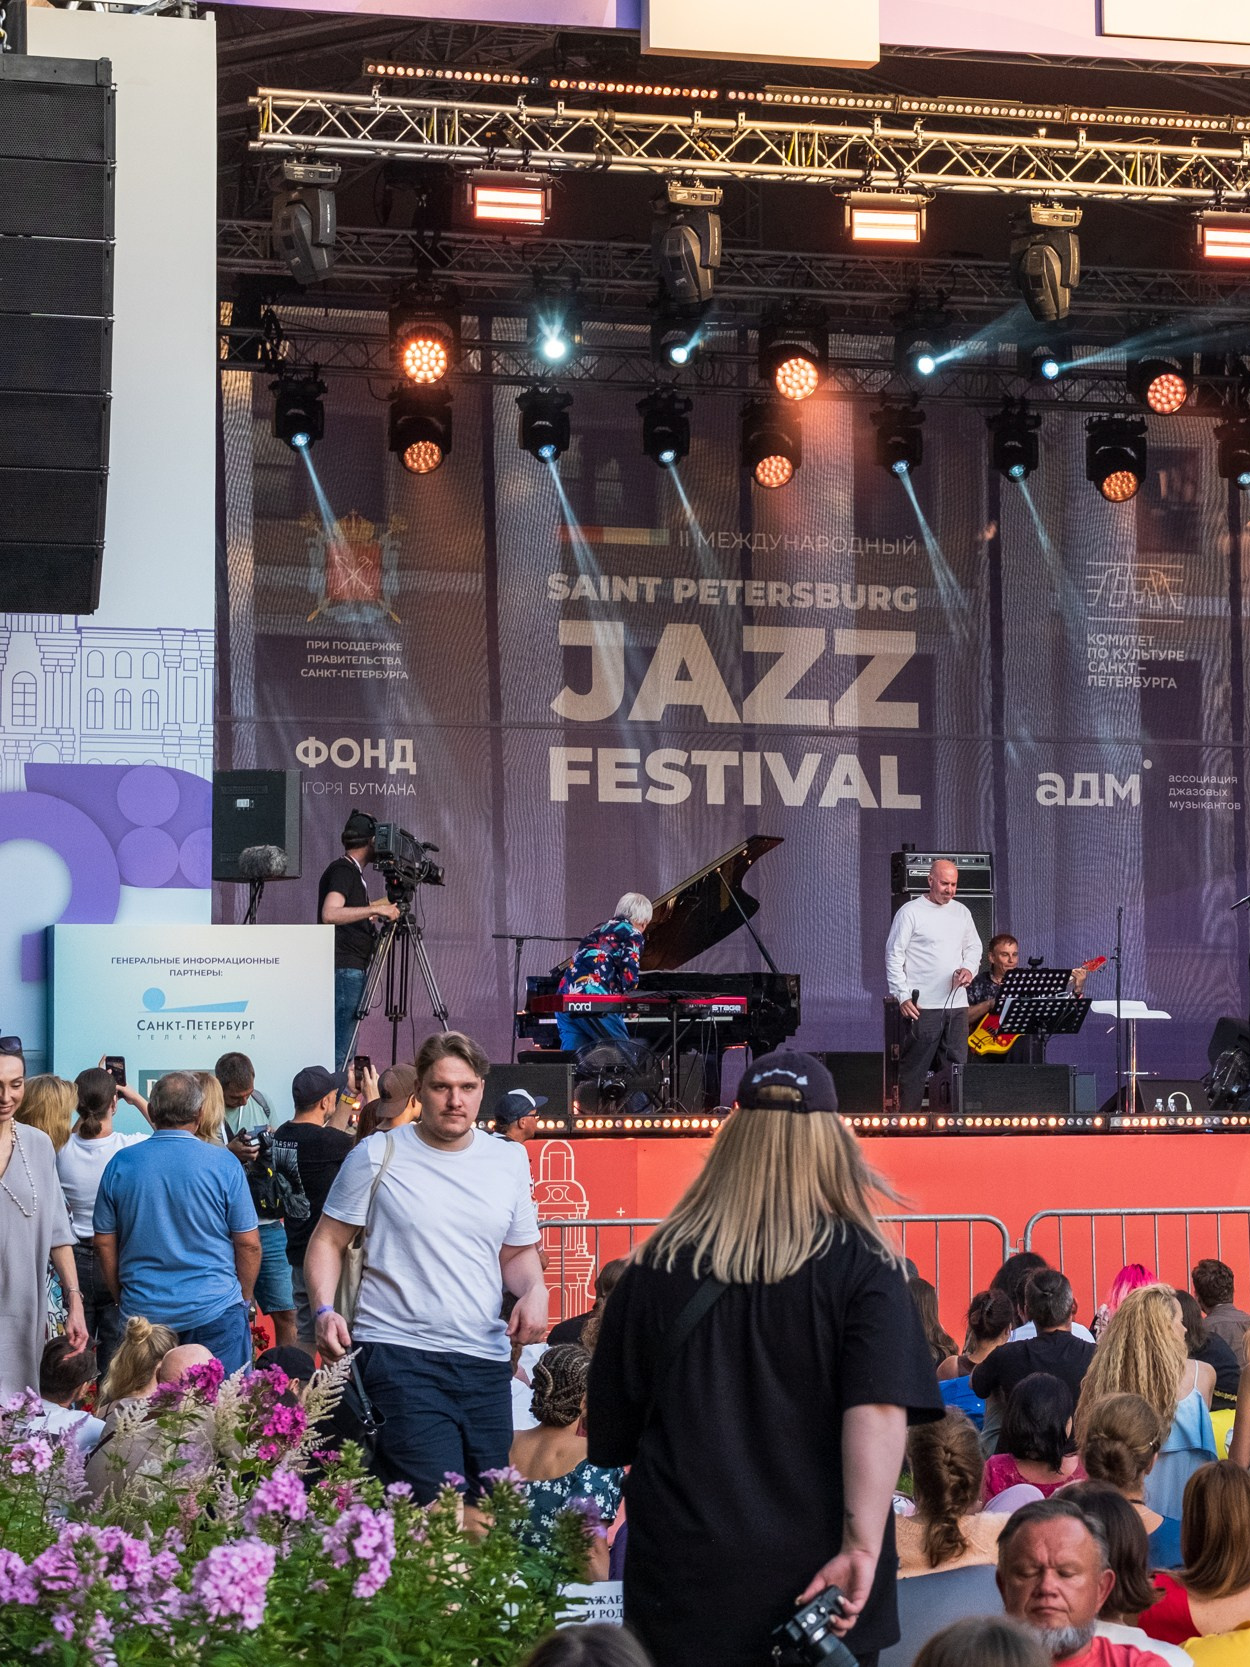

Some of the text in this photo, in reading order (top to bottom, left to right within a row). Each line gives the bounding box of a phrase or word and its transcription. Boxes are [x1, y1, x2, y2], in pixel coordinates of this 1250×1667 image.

[698, 530, 917, 557] МЕЖДУНАРОДНЫЙ
[547, 572, 918, 612] SAINT PETERSBURG
[1087, 633, 1155, 646] КОМИТЕТ
[306, 640, 402, 652] ПРИ ПОДДЕРЖКЕ
[307, 654, 402, 666] ПРАВИТЕЛЬСТВА
[1087, 647, 1185, 661] ПО КУЛЬТУРЕ
[300, 668, 409, 680] САНКТ-ПЕТЕРБУРГА
[549, 619, 920, 729] JAZZ
[1087, 675, 1178, 689] ПЕТЕРБУРГА
[295, 736, 417, 775] ФОНД
[548, 745, 922, 810] FESTIVAL
[1168, 774, 1238, 785] ассоциация
[349, 782, 417, 796] БУТМАНА
[1168, 786, 1228, 798] джазовых
[1169, 801, 1241, 812] музыкантов
[111, 957, 280, 965] ГЕНЕРАЛЬНЫЕ ИНФОРМАЦИОННЫЕ
[169, 969, 223, 977] ПАРТНЕРЫ:
[568, 1001, 592, 1011] nord
[600, 1608, 624, 1619] РОД
